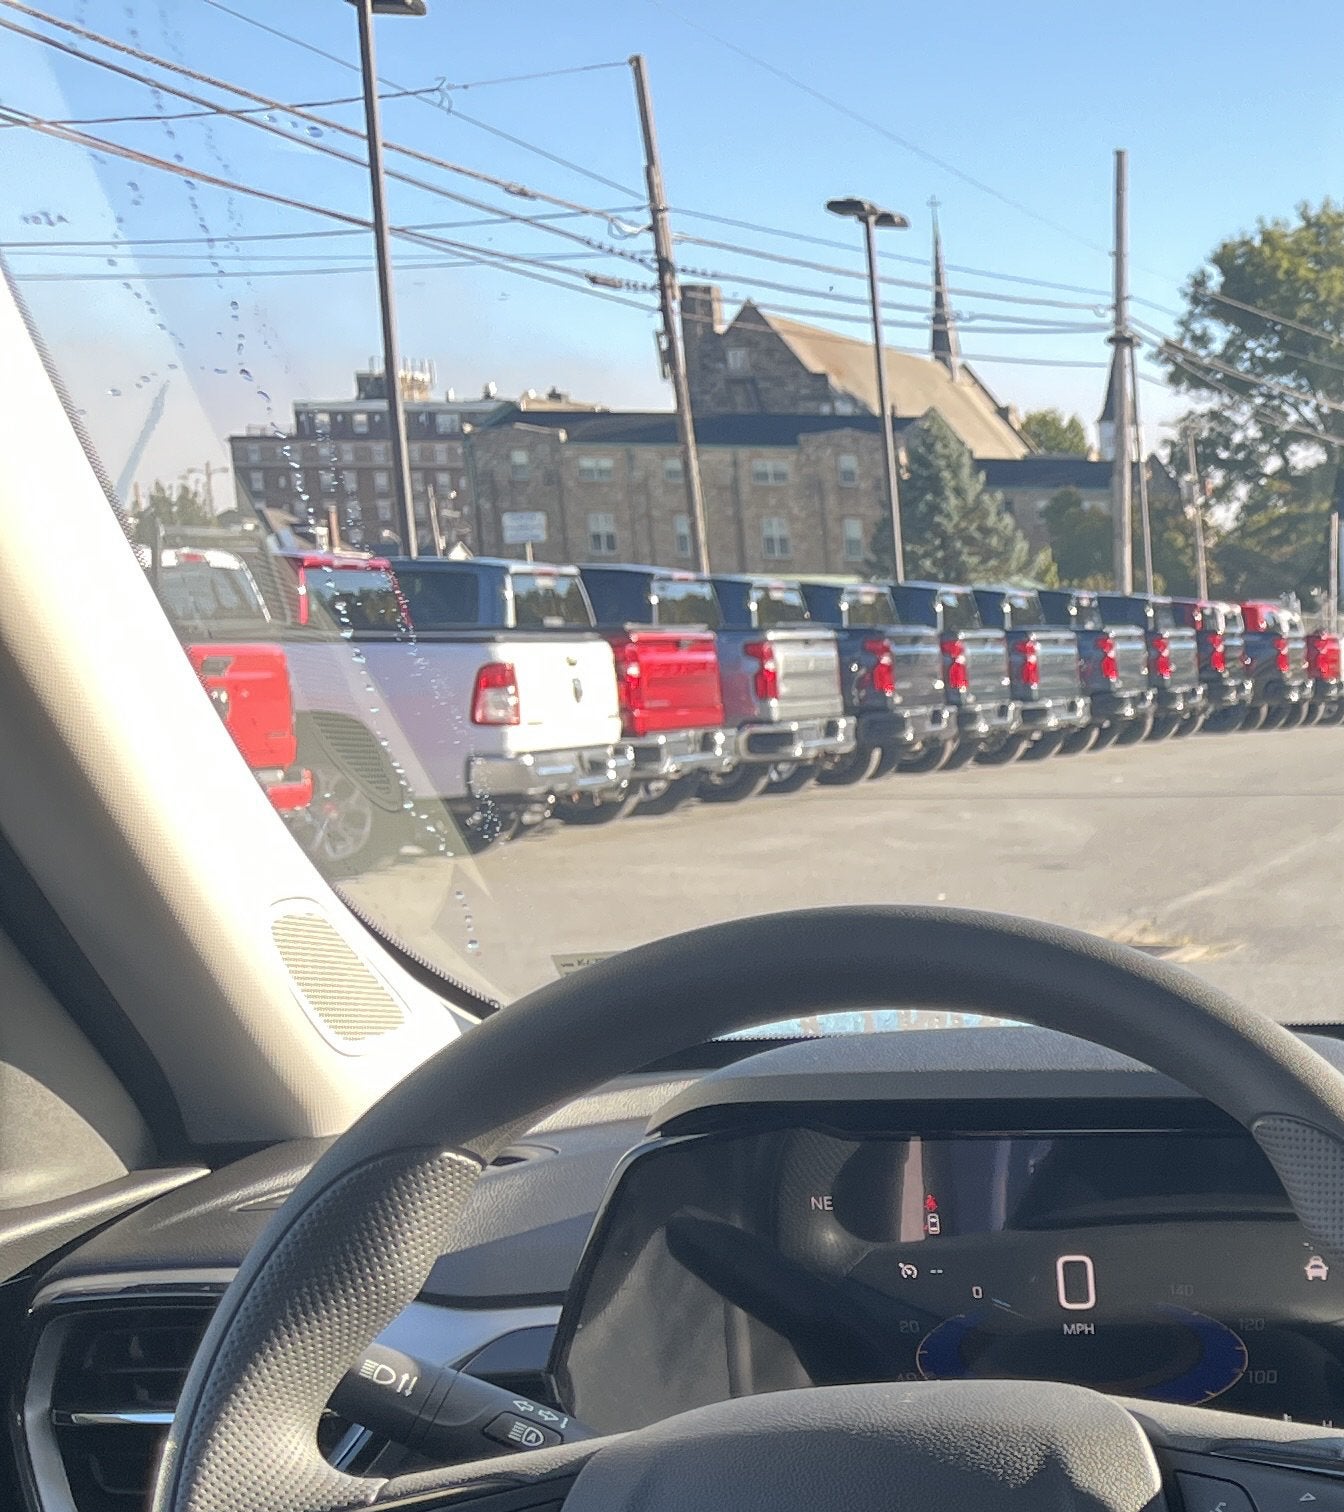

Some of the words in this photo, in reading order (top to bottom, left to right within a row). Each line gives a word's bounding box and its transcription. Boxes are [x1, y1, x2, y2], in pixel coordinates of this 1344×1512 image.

[810, 1195, 834, 1211] NE
[1055, 1254, 1096, 1310] 0
[972, 1285, 983, 1299] 0
[1063, 1322, 1096, 1335] MPH
[1238, 1318, 1267, 1332] 120
[1248, 1370, 1278, 1385] 100
